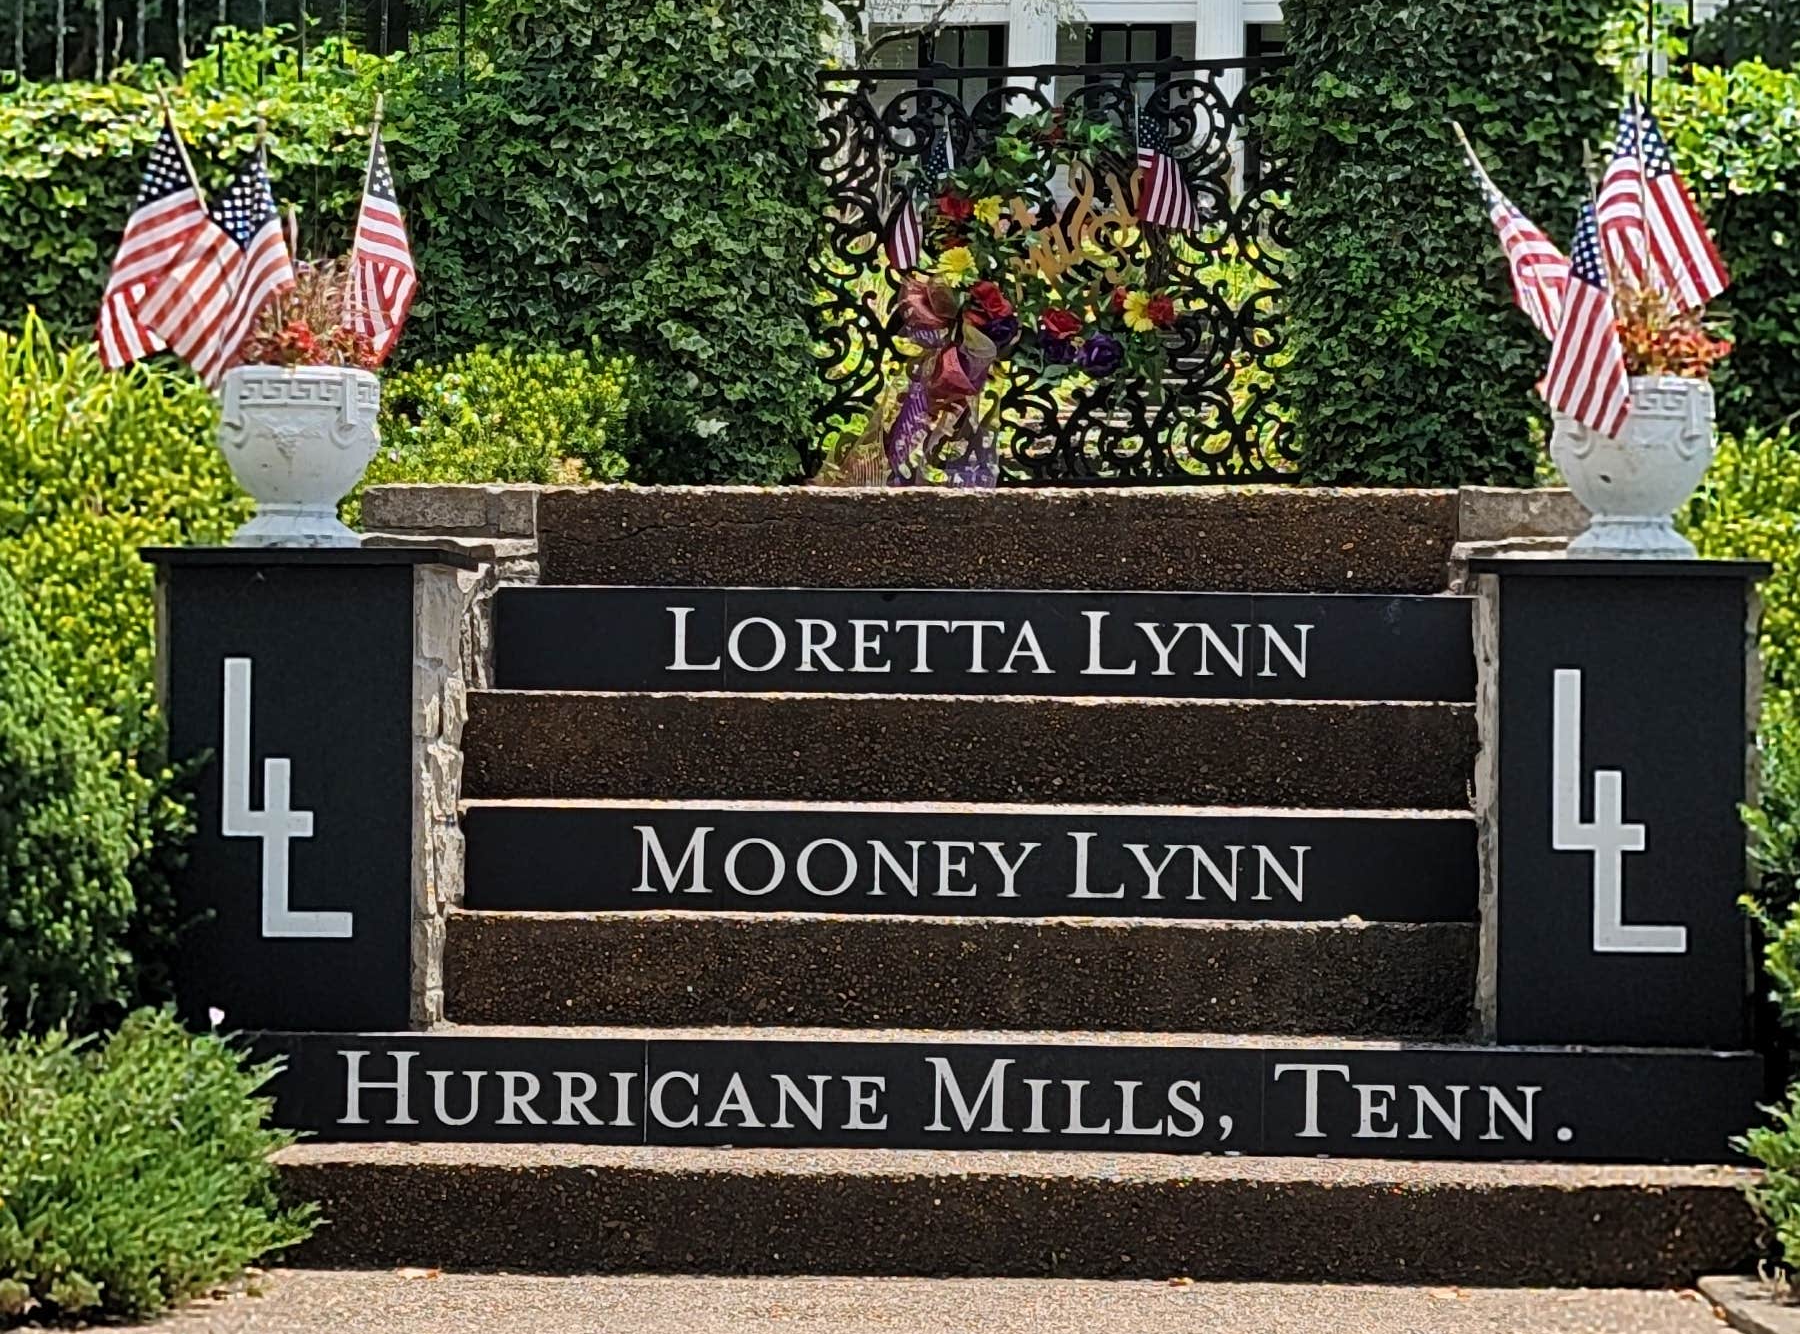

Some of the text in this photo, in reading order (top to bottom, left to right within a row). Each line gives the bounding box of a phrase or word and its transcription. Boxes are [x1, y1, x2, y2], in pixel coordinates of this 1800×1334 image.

[665, 607, 1315, 679] LORETTA LYNN
[631, 825, 1312, 903] MOONEY LYNN
[337, 1050, 1574, 1142] HURRICANE MILLS, TENN.
